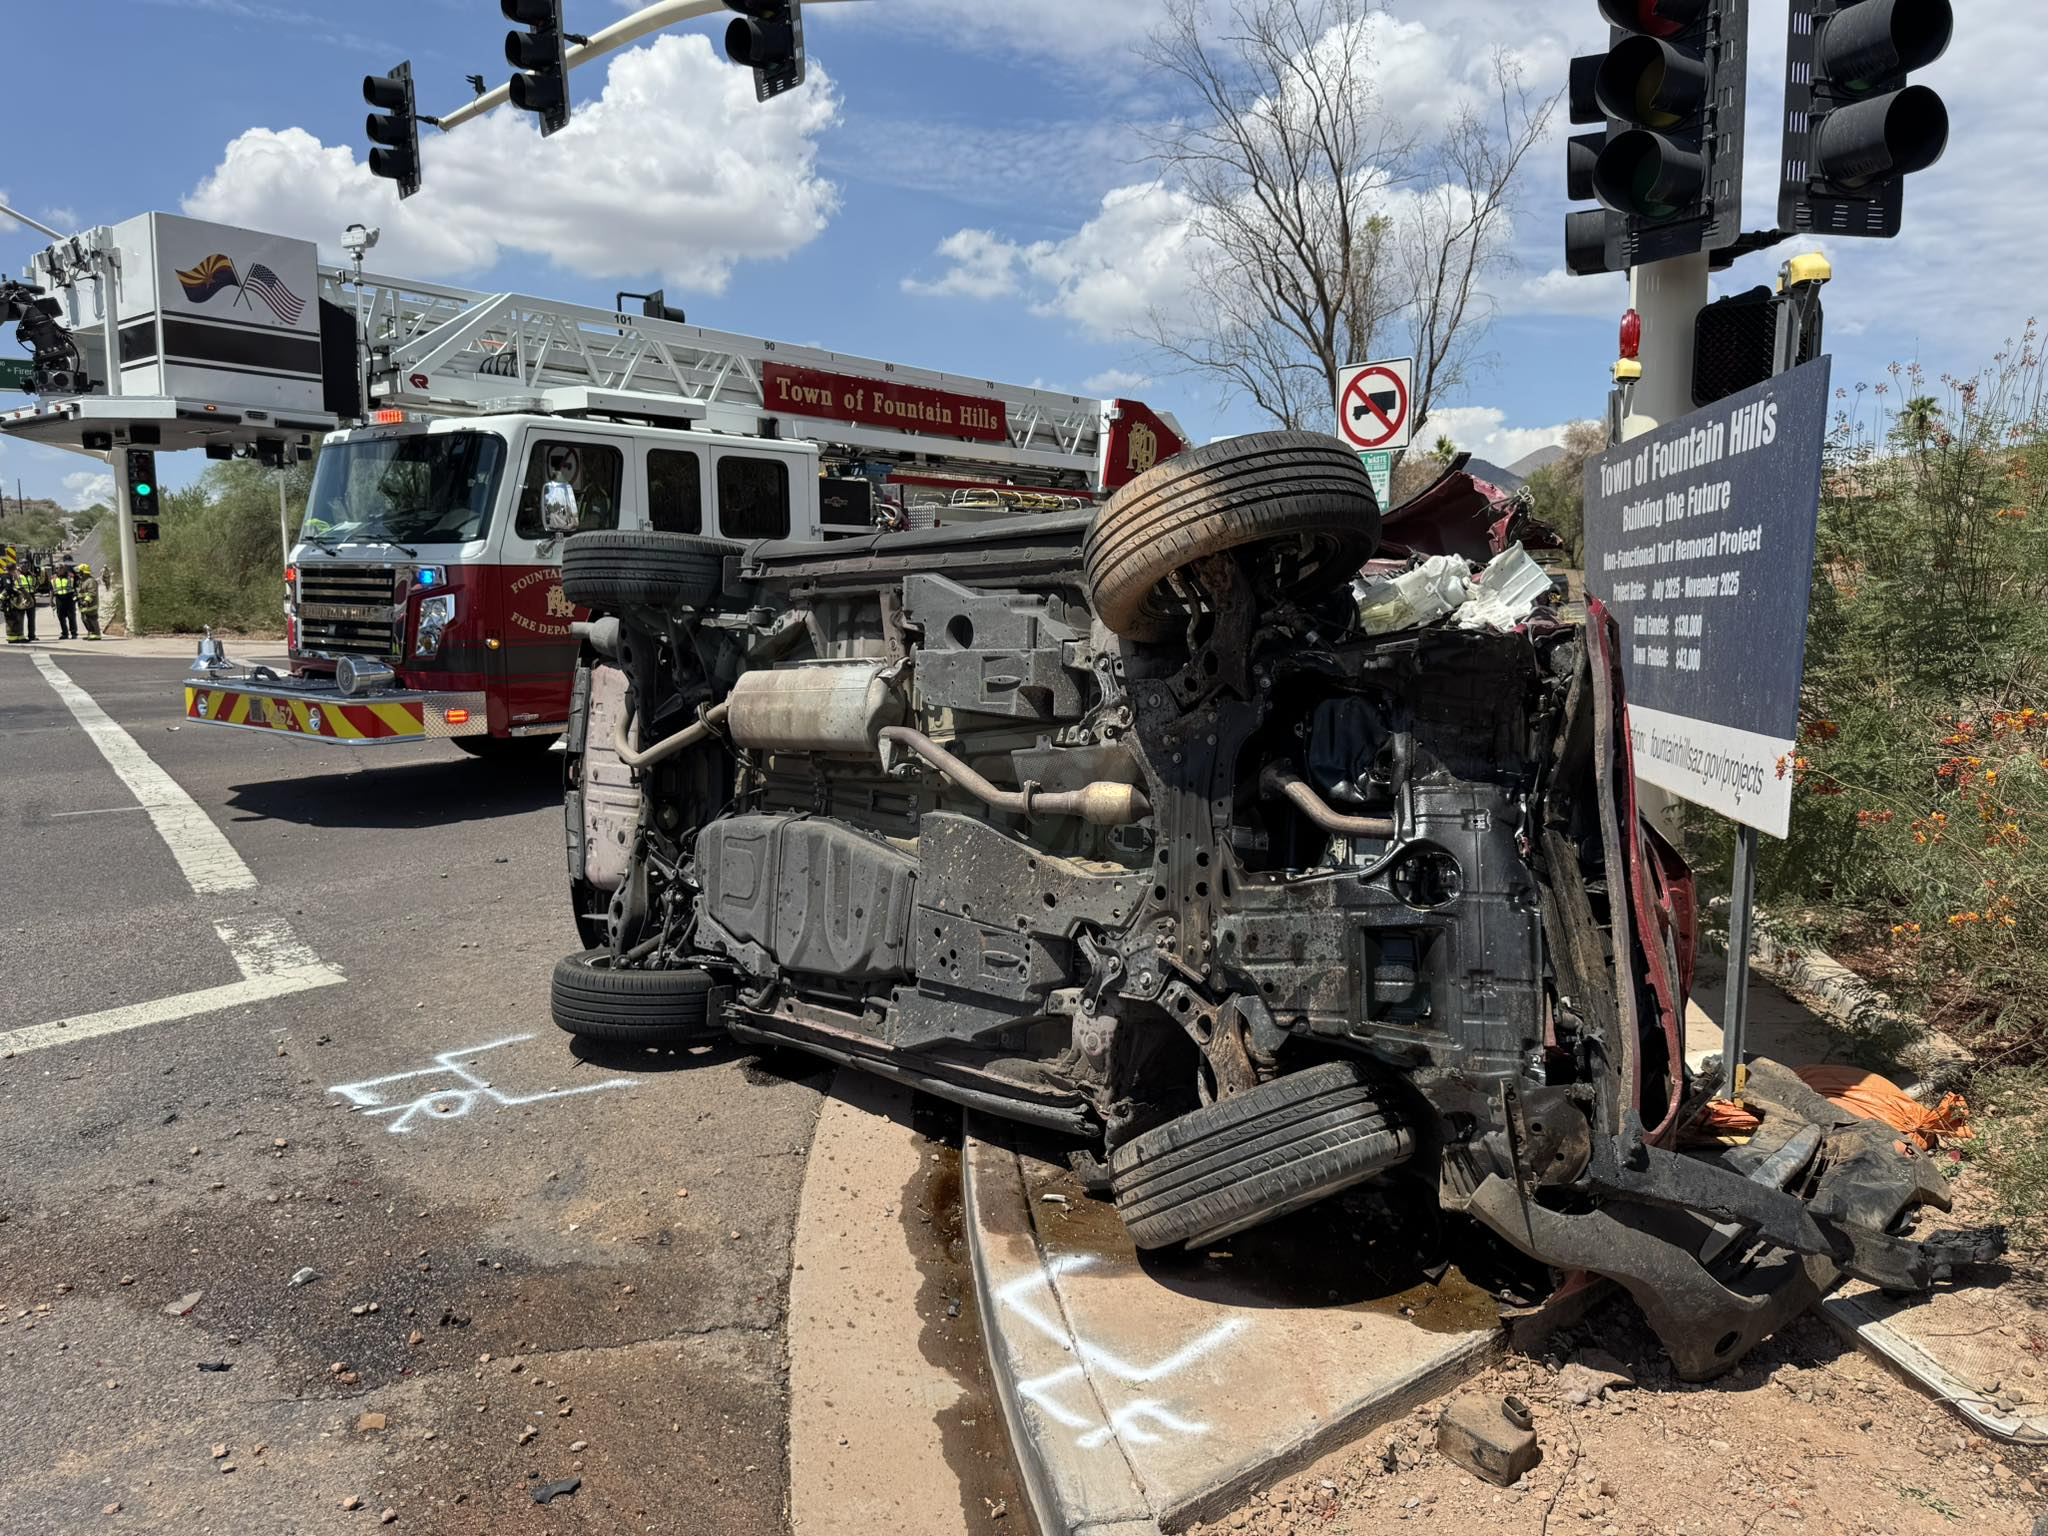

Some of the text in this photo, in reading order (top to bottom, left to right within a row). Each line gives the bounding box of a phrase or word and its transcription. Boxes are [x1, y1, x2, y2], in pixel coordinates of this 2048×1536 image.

[613, 314, 633, 326] 101
[764, 341, 775, 351] 90
[13, 366, 33, 376] Firer
[885, 363, 894, 373] 80
[986, 381, 994, 390] 70
[776, 376, 998, 430] Town of Fountain Hills
[1072, 396, 1080, 404] 60
[1600, 399, 1777, 498] Town of Fountain Hills
[1622, 480, 1731, 533] Building the Future
[1603, 523, 1763, 571] Non-Functional Turf Removal Project
[510, 568, 562, 594] FOUNTAI
[1652, 578, 1665, 602] July
[1665, 576, 1681, 599] 2025
[1685, 574, 1719, 598] November
[1720, 571, 1740, 597] 2025
[511, 611, 537, 632] FIRE
[1650, 727, 1765, 799] fountainhillsaz.gov/projects
